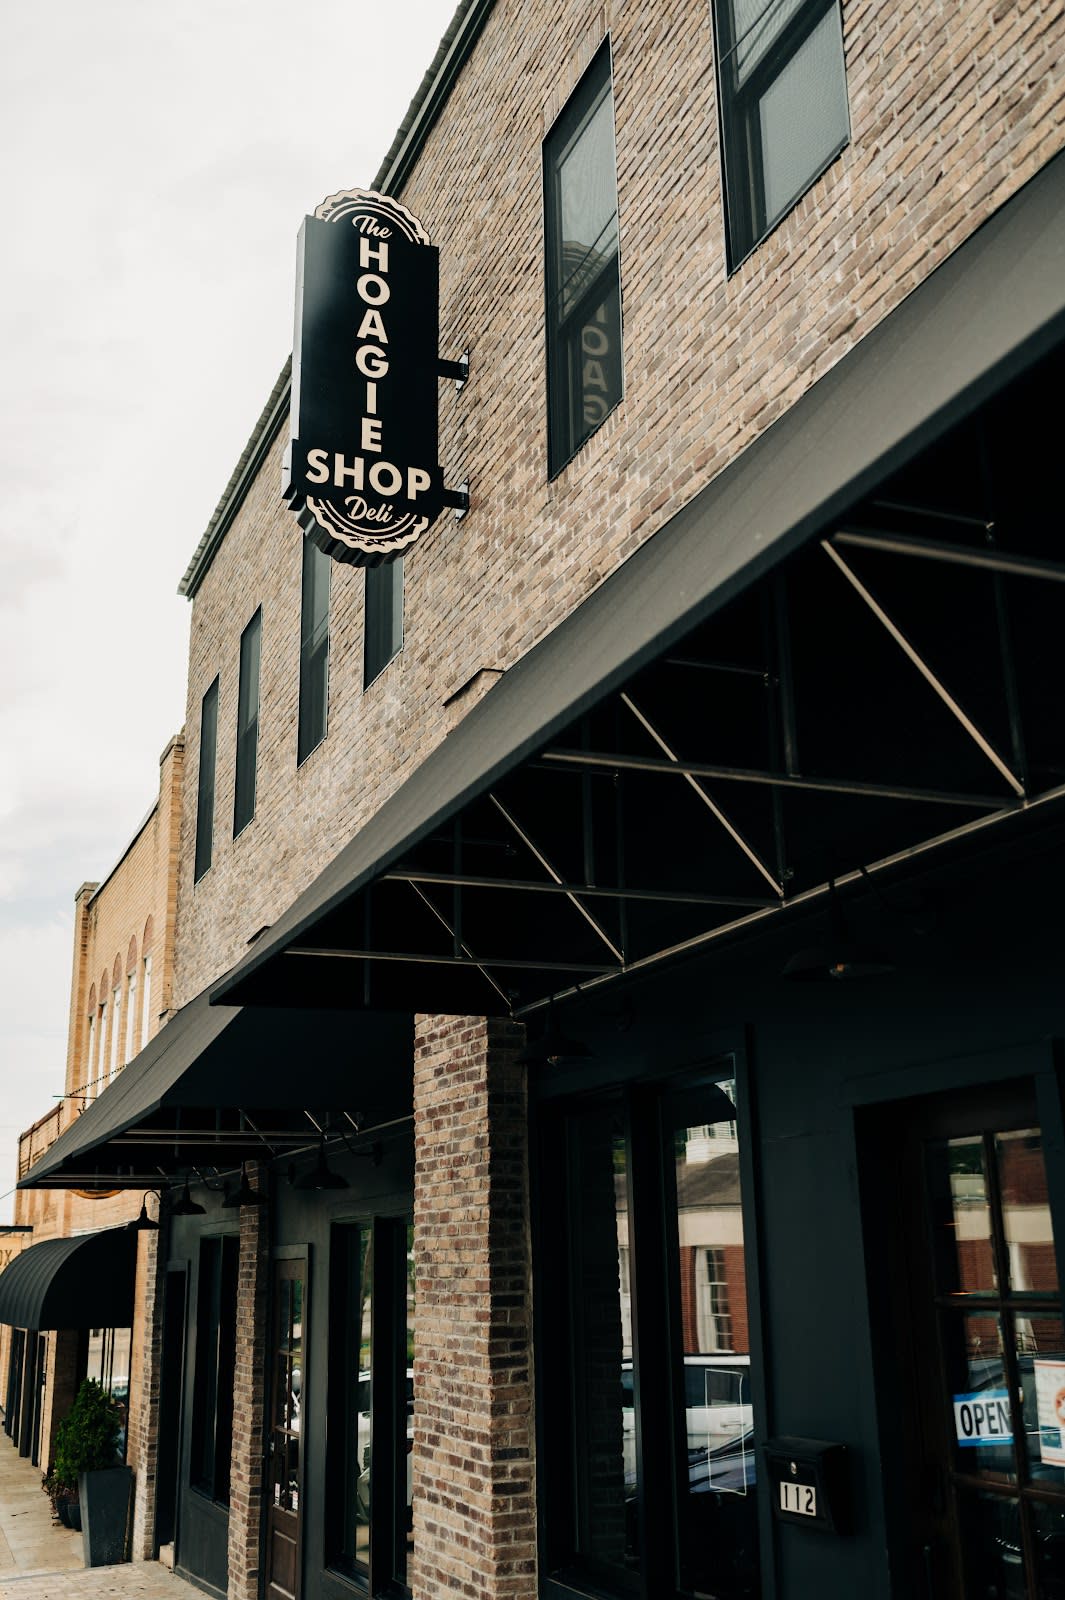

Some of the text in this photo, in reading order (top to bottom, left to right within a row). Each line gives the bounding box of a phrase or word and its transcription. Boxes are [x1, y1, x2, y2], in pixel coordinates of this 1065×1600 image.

[352, 215, 392, 238] The
[355, 237, 390, 452] HOAGIE
[305, 448, 431, 500] SHOP
[344, 495, 393, 523] Deli
[960, 1401, 1013, 1436] OPEN
[784, 1484, 814, 1513] 112
